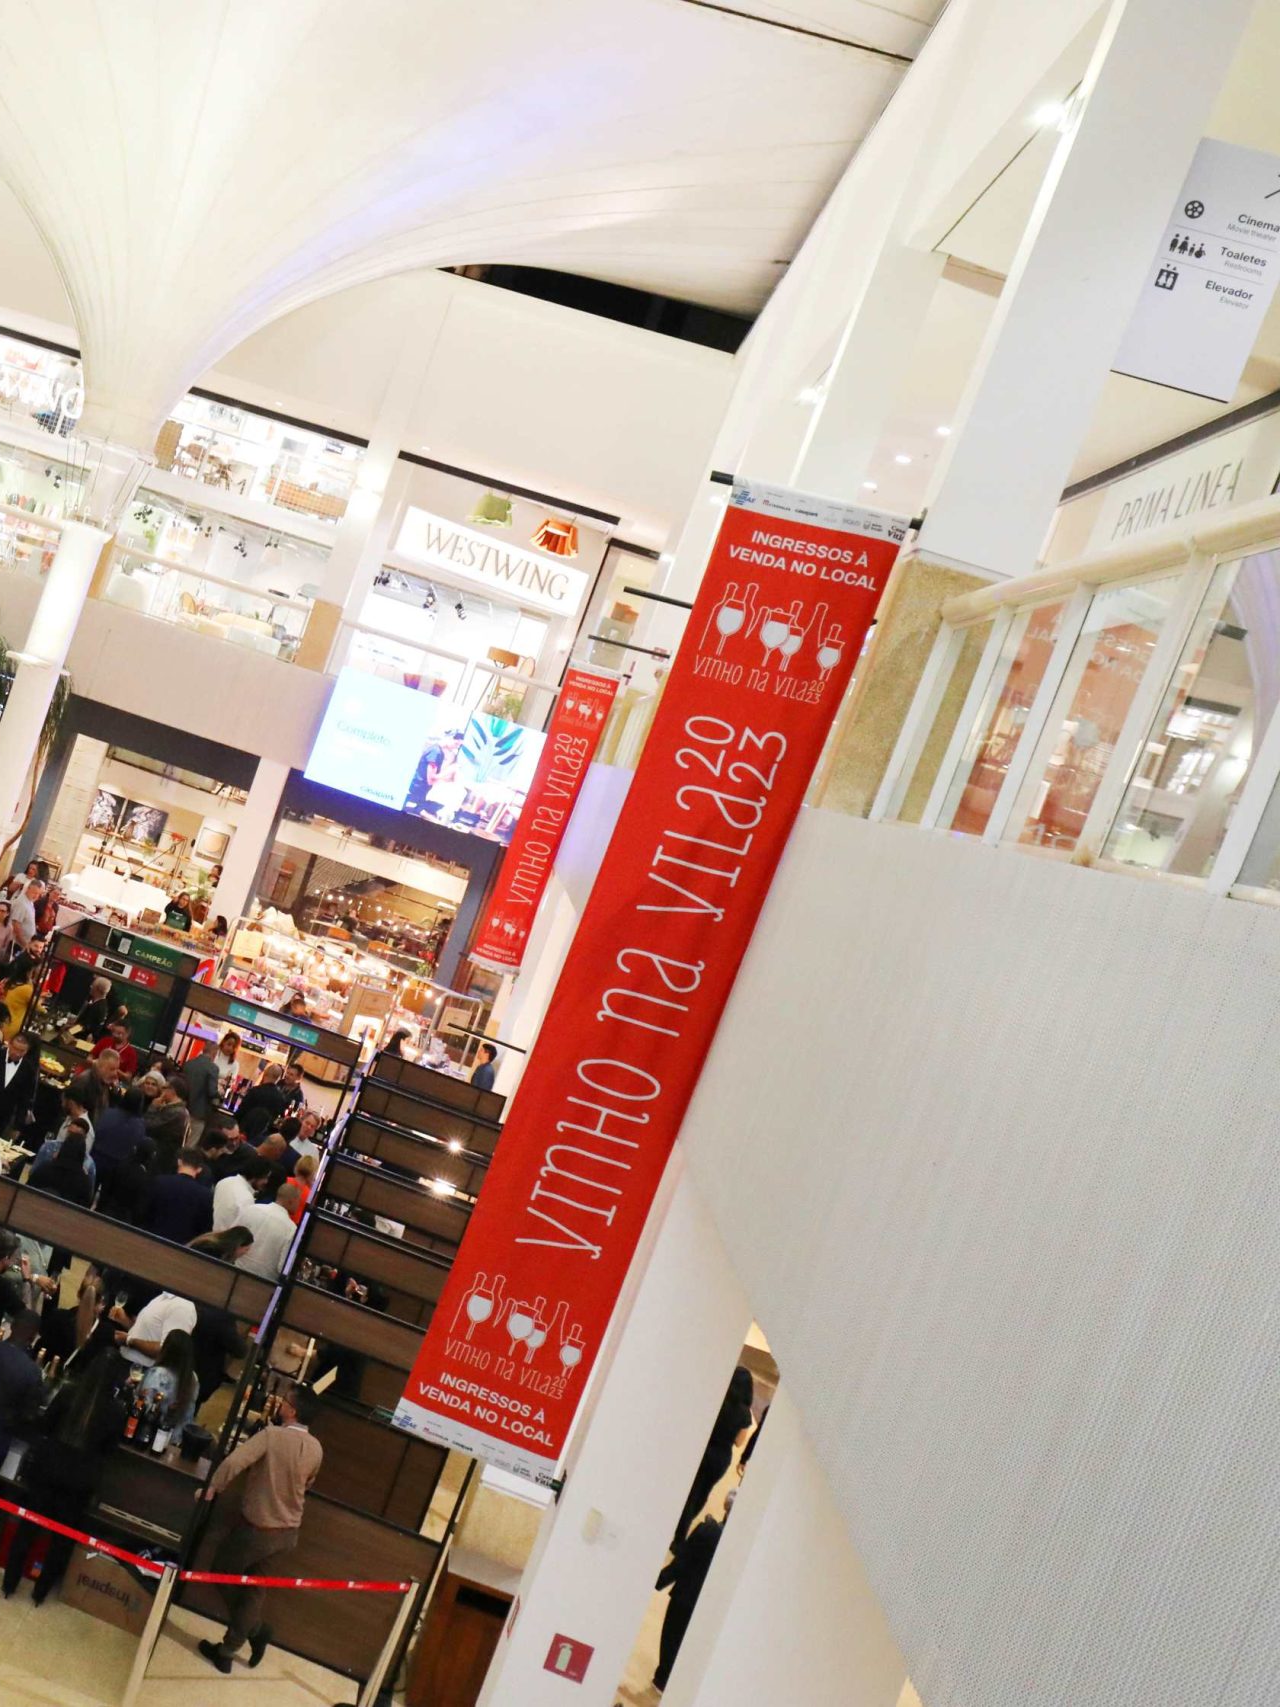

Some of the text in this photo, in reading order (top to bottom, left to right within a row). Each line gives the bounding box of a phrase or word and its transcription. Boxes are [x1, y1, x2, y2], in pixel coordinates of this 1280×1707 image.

[1237, 213, 1280, 233] Cinema
[1220, 246, 1268, 267] Toaletes
[1223, 260, 1263, 277] Restrooms
[1205, 279, 1254, 301] Elevador
[1219, 296, 1249, 310] Elevator
[1111, 457, 1244, 541] PRIMA LINEA
[425, 522, 570, 601] WESTWING
[751, 530, 869, 568] INGRESSOS À
[729, 544, 876, 591] VENDA NO LOCAL
[134, 950, 173, 968] CAMPEÃO
[439, 1372, 531, 1418] INGRESSOS
[419, 1382, 555, 1447] VENDA NO LOCAL
